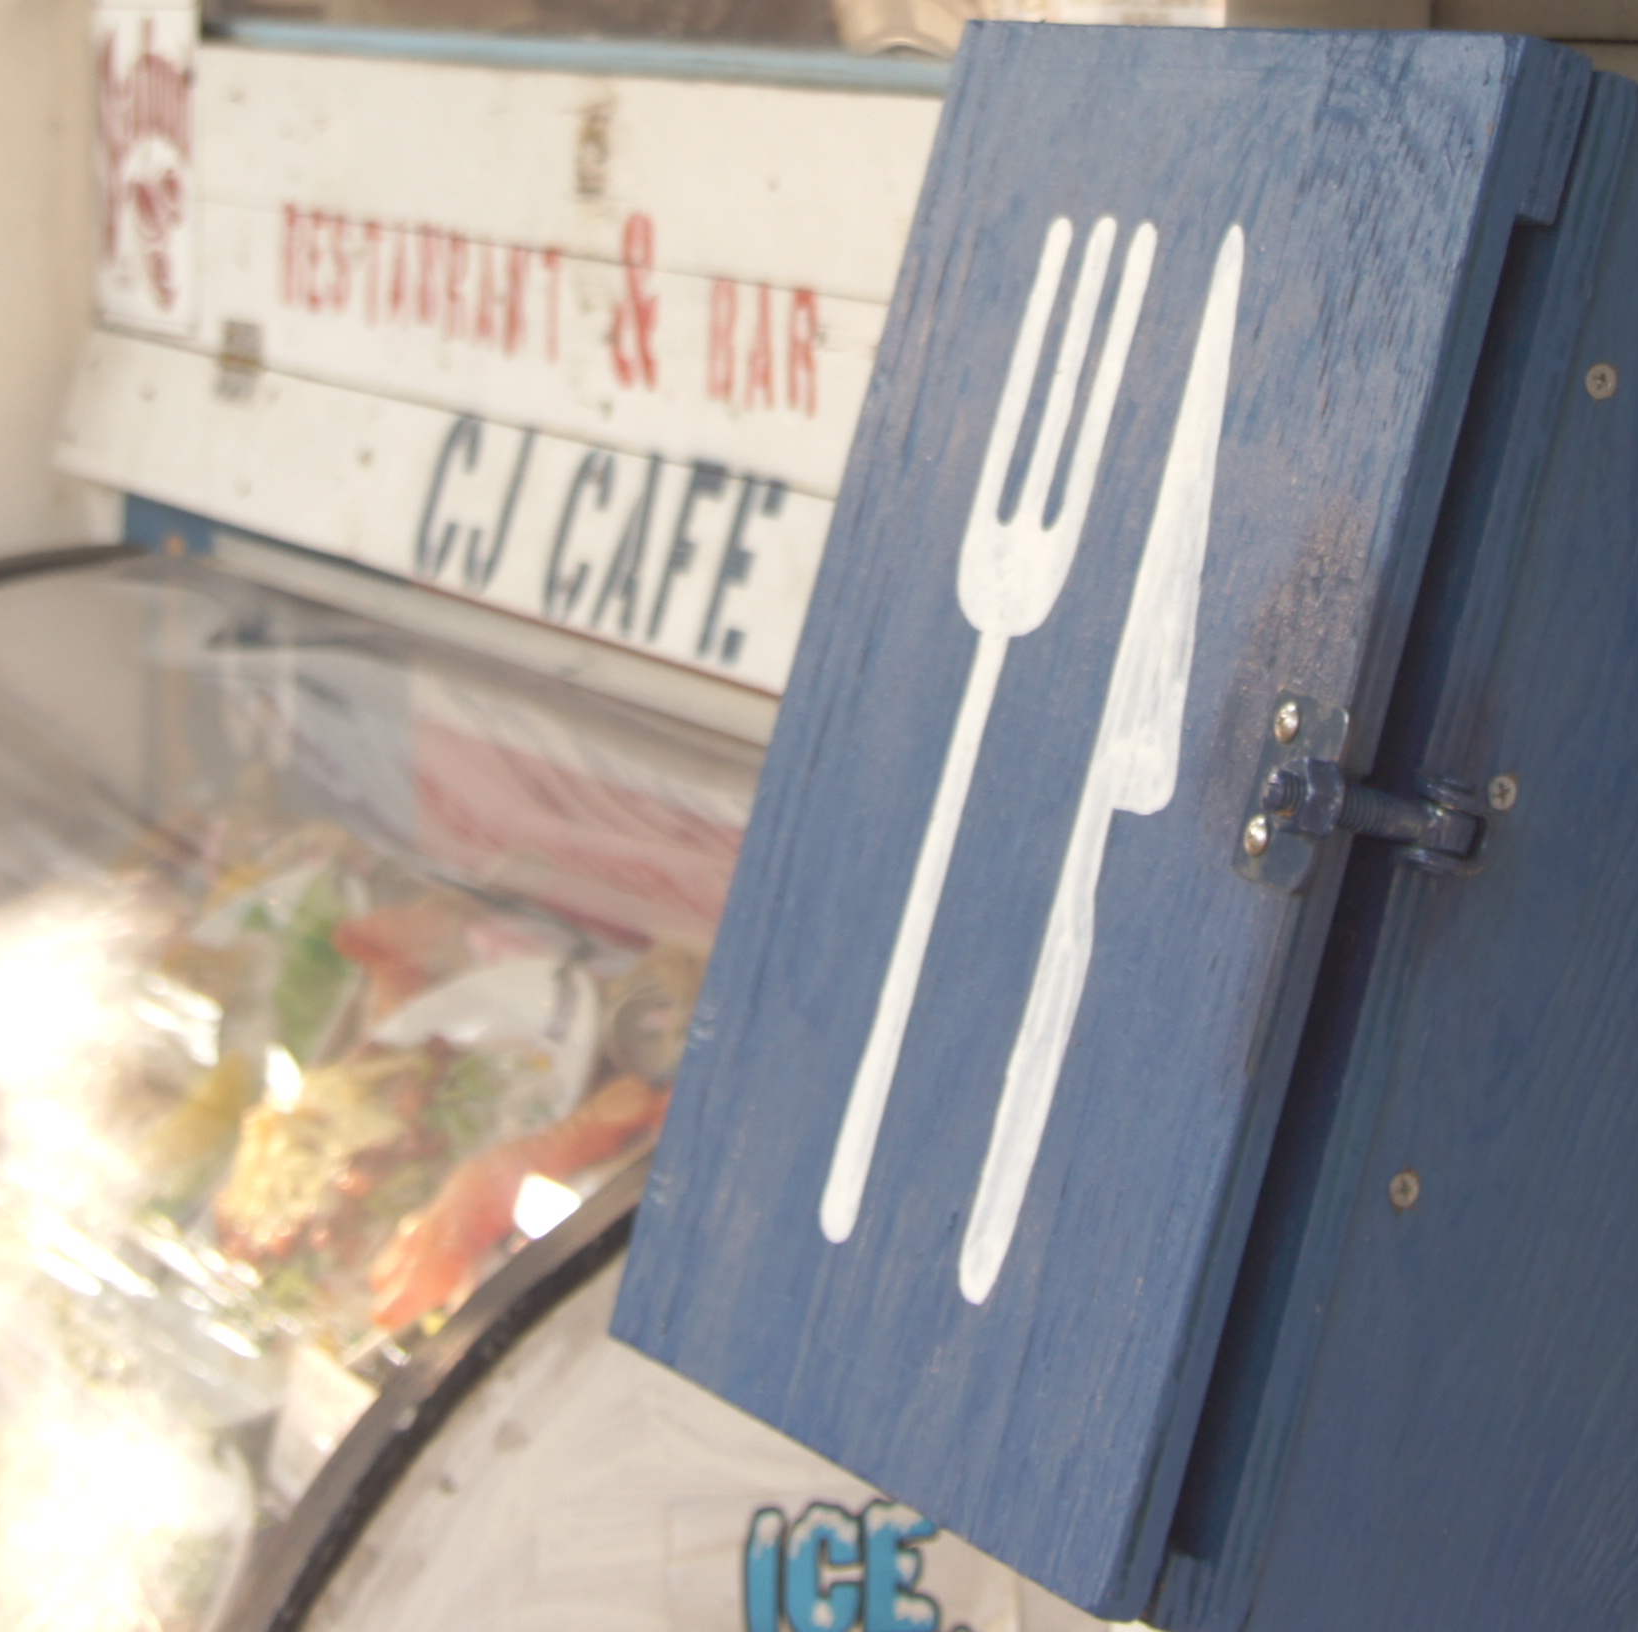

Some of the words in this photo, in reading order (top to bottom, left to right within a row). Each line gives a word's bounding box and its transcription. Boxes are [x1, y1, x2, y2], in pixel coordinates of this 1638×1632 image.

[279, 202, 567, 366] RESTAURANT
[609, 212, 661, 392] &
[707, 274, 821, 418] BAR
[415, 412, 543, 596] CJ
[543, 446, 788, 668] CAFE
[743, 1499, 941, 1632] ICE
